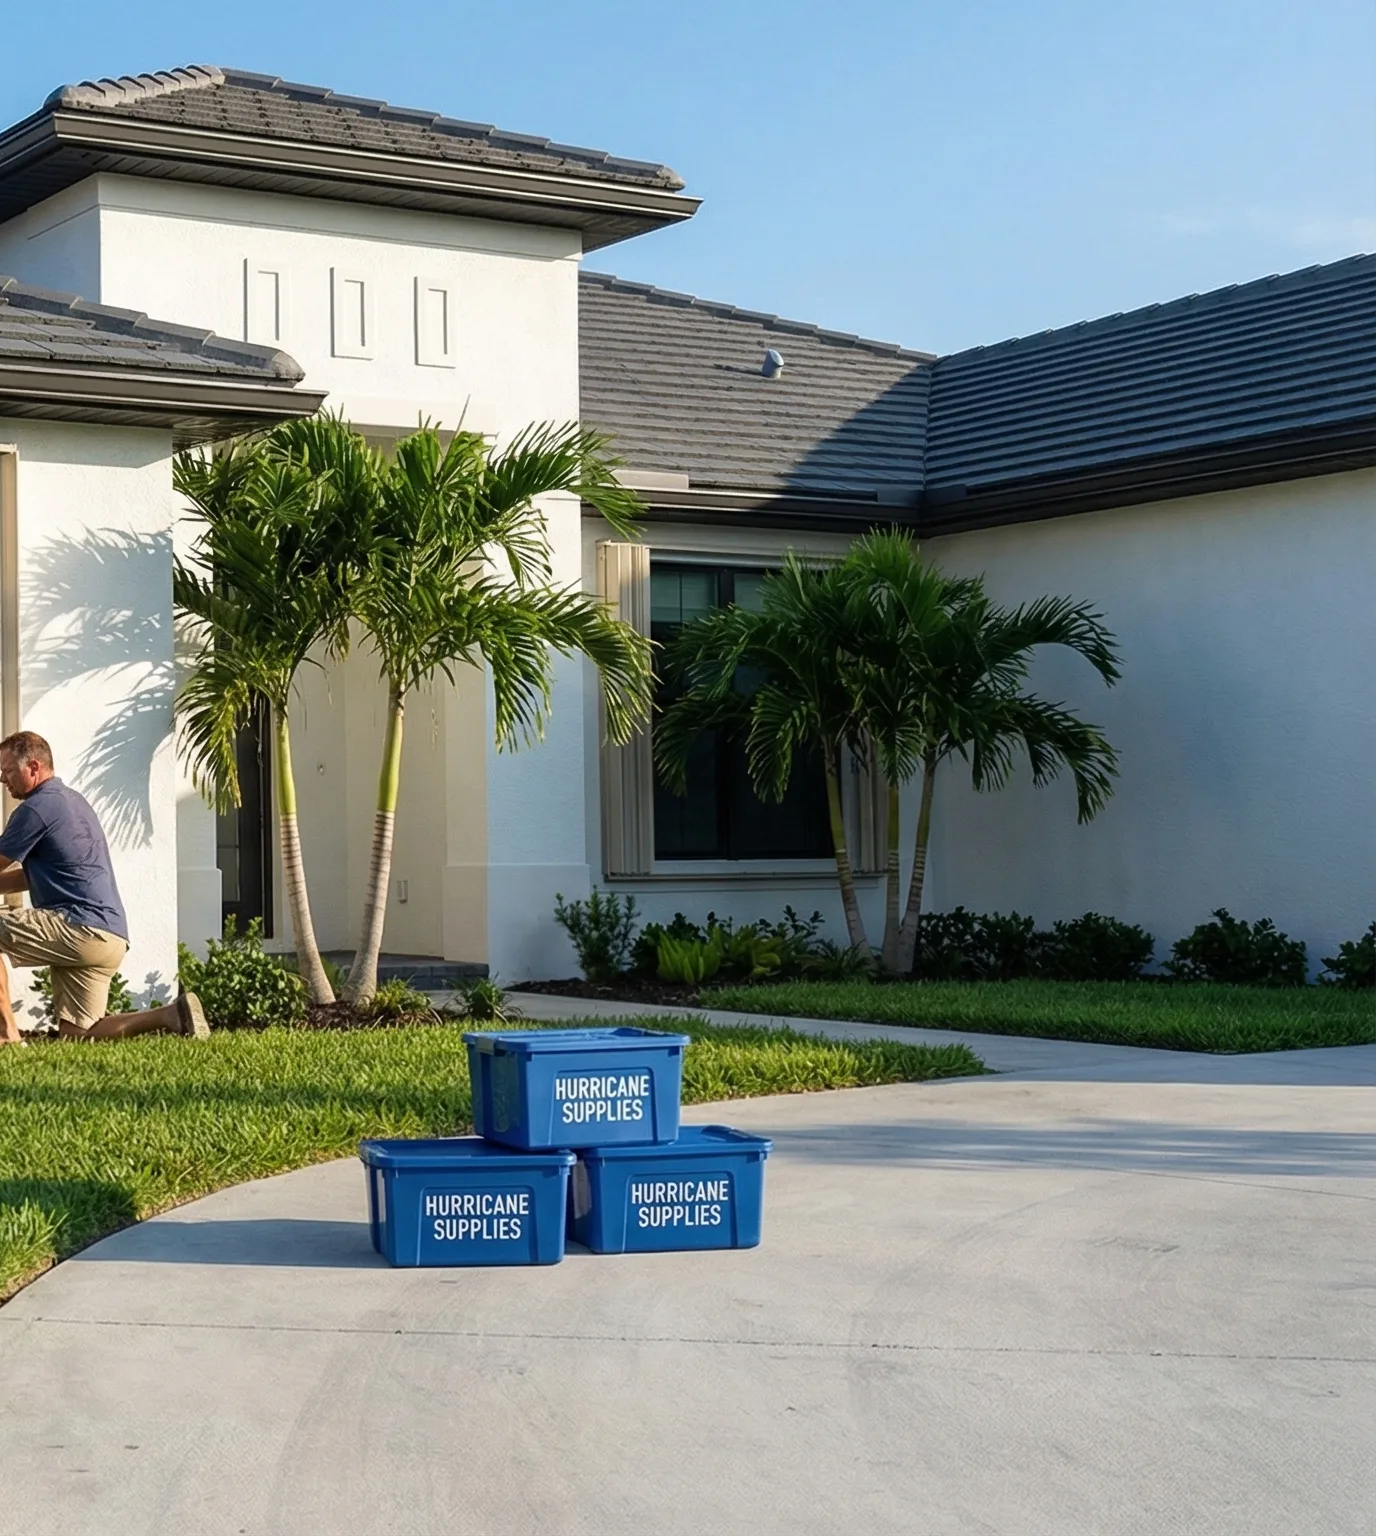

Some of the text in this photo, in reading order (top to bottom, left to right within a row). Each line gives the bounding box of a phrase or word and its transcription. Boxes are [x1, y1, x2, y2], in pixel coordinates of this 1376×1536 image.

[556, 1076, 649, 1099] HURRICANE
[563, 1099, 643, 1123] SUPPLIES
[632, 1181, 728, 1204] HURRICANE
[426, 1194, 528, 1216] HURRICANE
[639, 1205, 720, 1227] SUPPLIES
[434, 1218, 520, 1240] SUPPLIES
